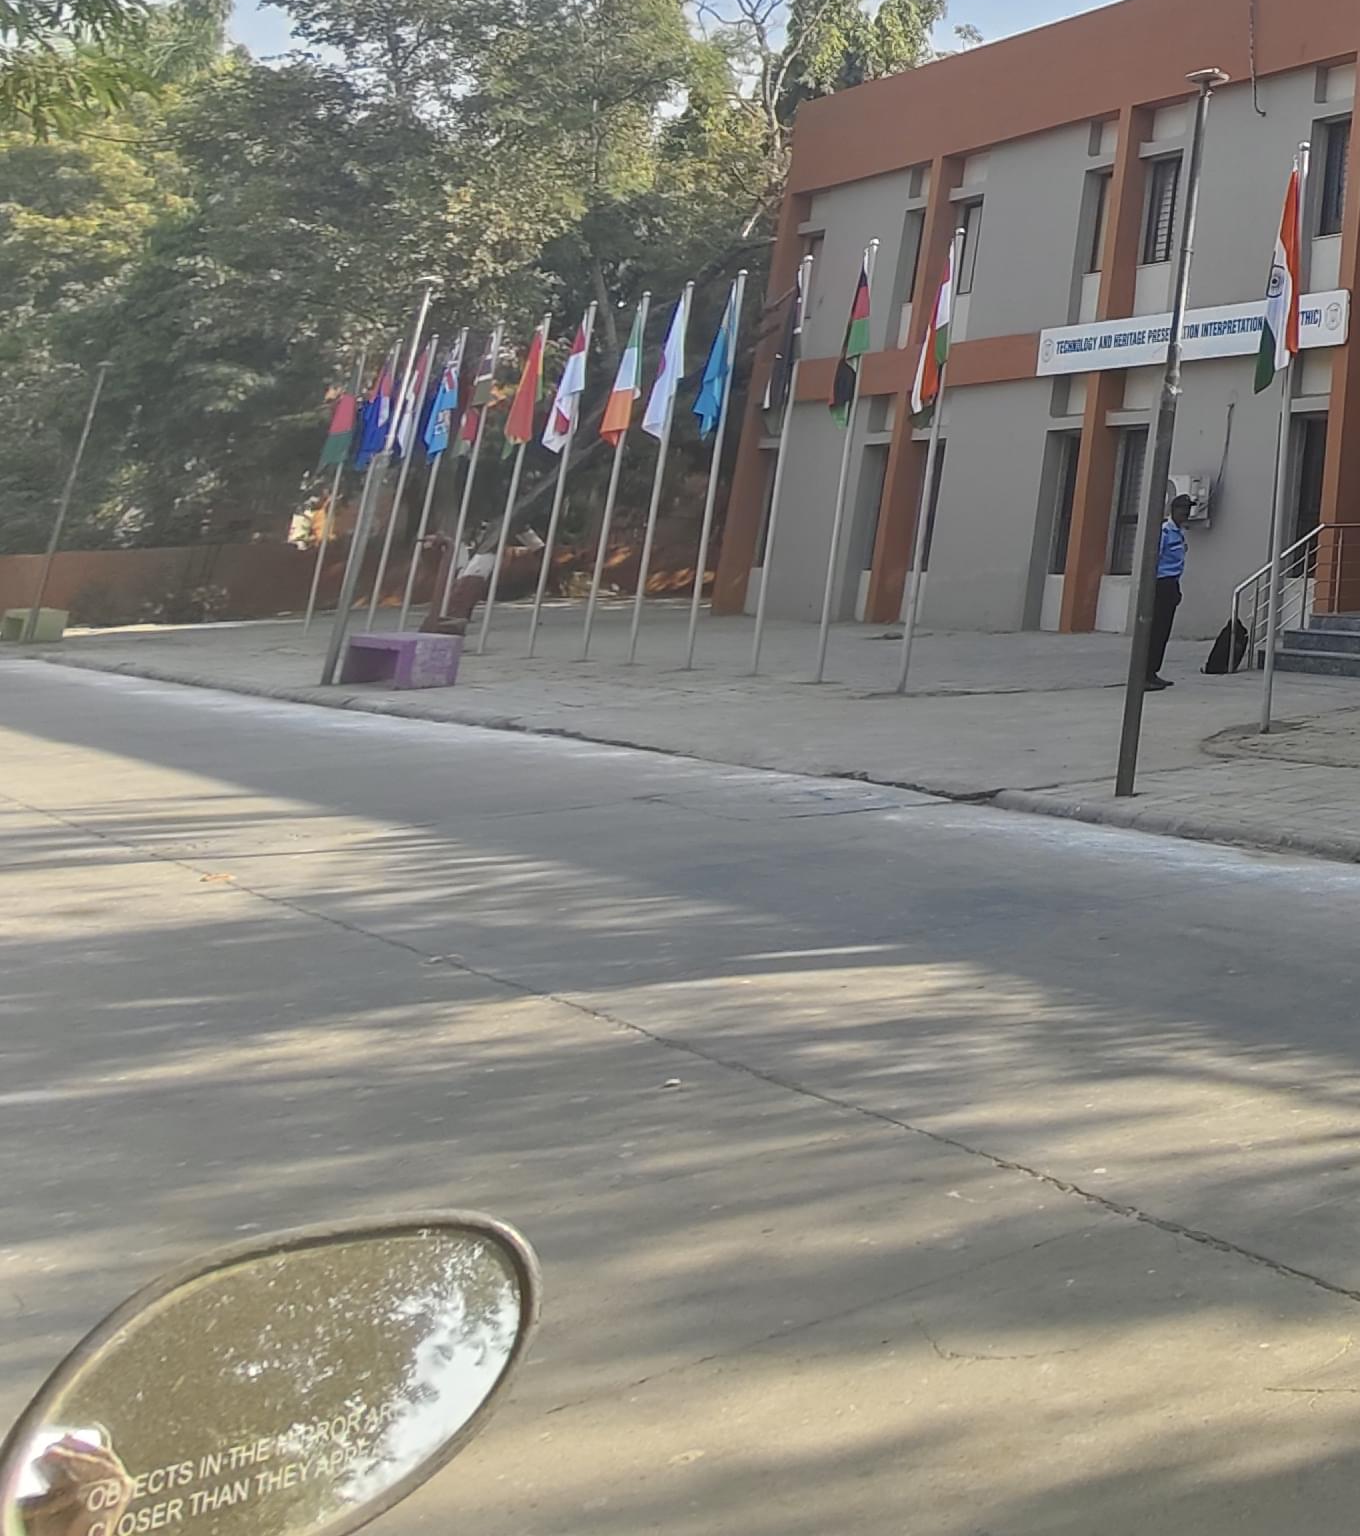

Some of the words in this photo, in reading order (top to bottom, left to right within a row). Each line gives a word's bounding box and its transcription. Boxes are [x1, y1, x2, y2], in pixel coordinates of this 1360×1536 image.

[1056, 335, 1098, 355] TECHNOLOGY
[1098, 333, 1113, 350] AND
[1113, 330, 1147, 348] HERITAGE
[1147, 322, 1199, 344] PRESETION
[1200, 315, 1264, 337] INTERPRETATION
[87, 1460, 195, 1512] OBECTS
[228, 1437, 271, 1470] THE
[88, 1498, 184, 1536] COSER
[188, 1477, 251, 1517] THAN
[254, 1458, 313, 1496] THEY
